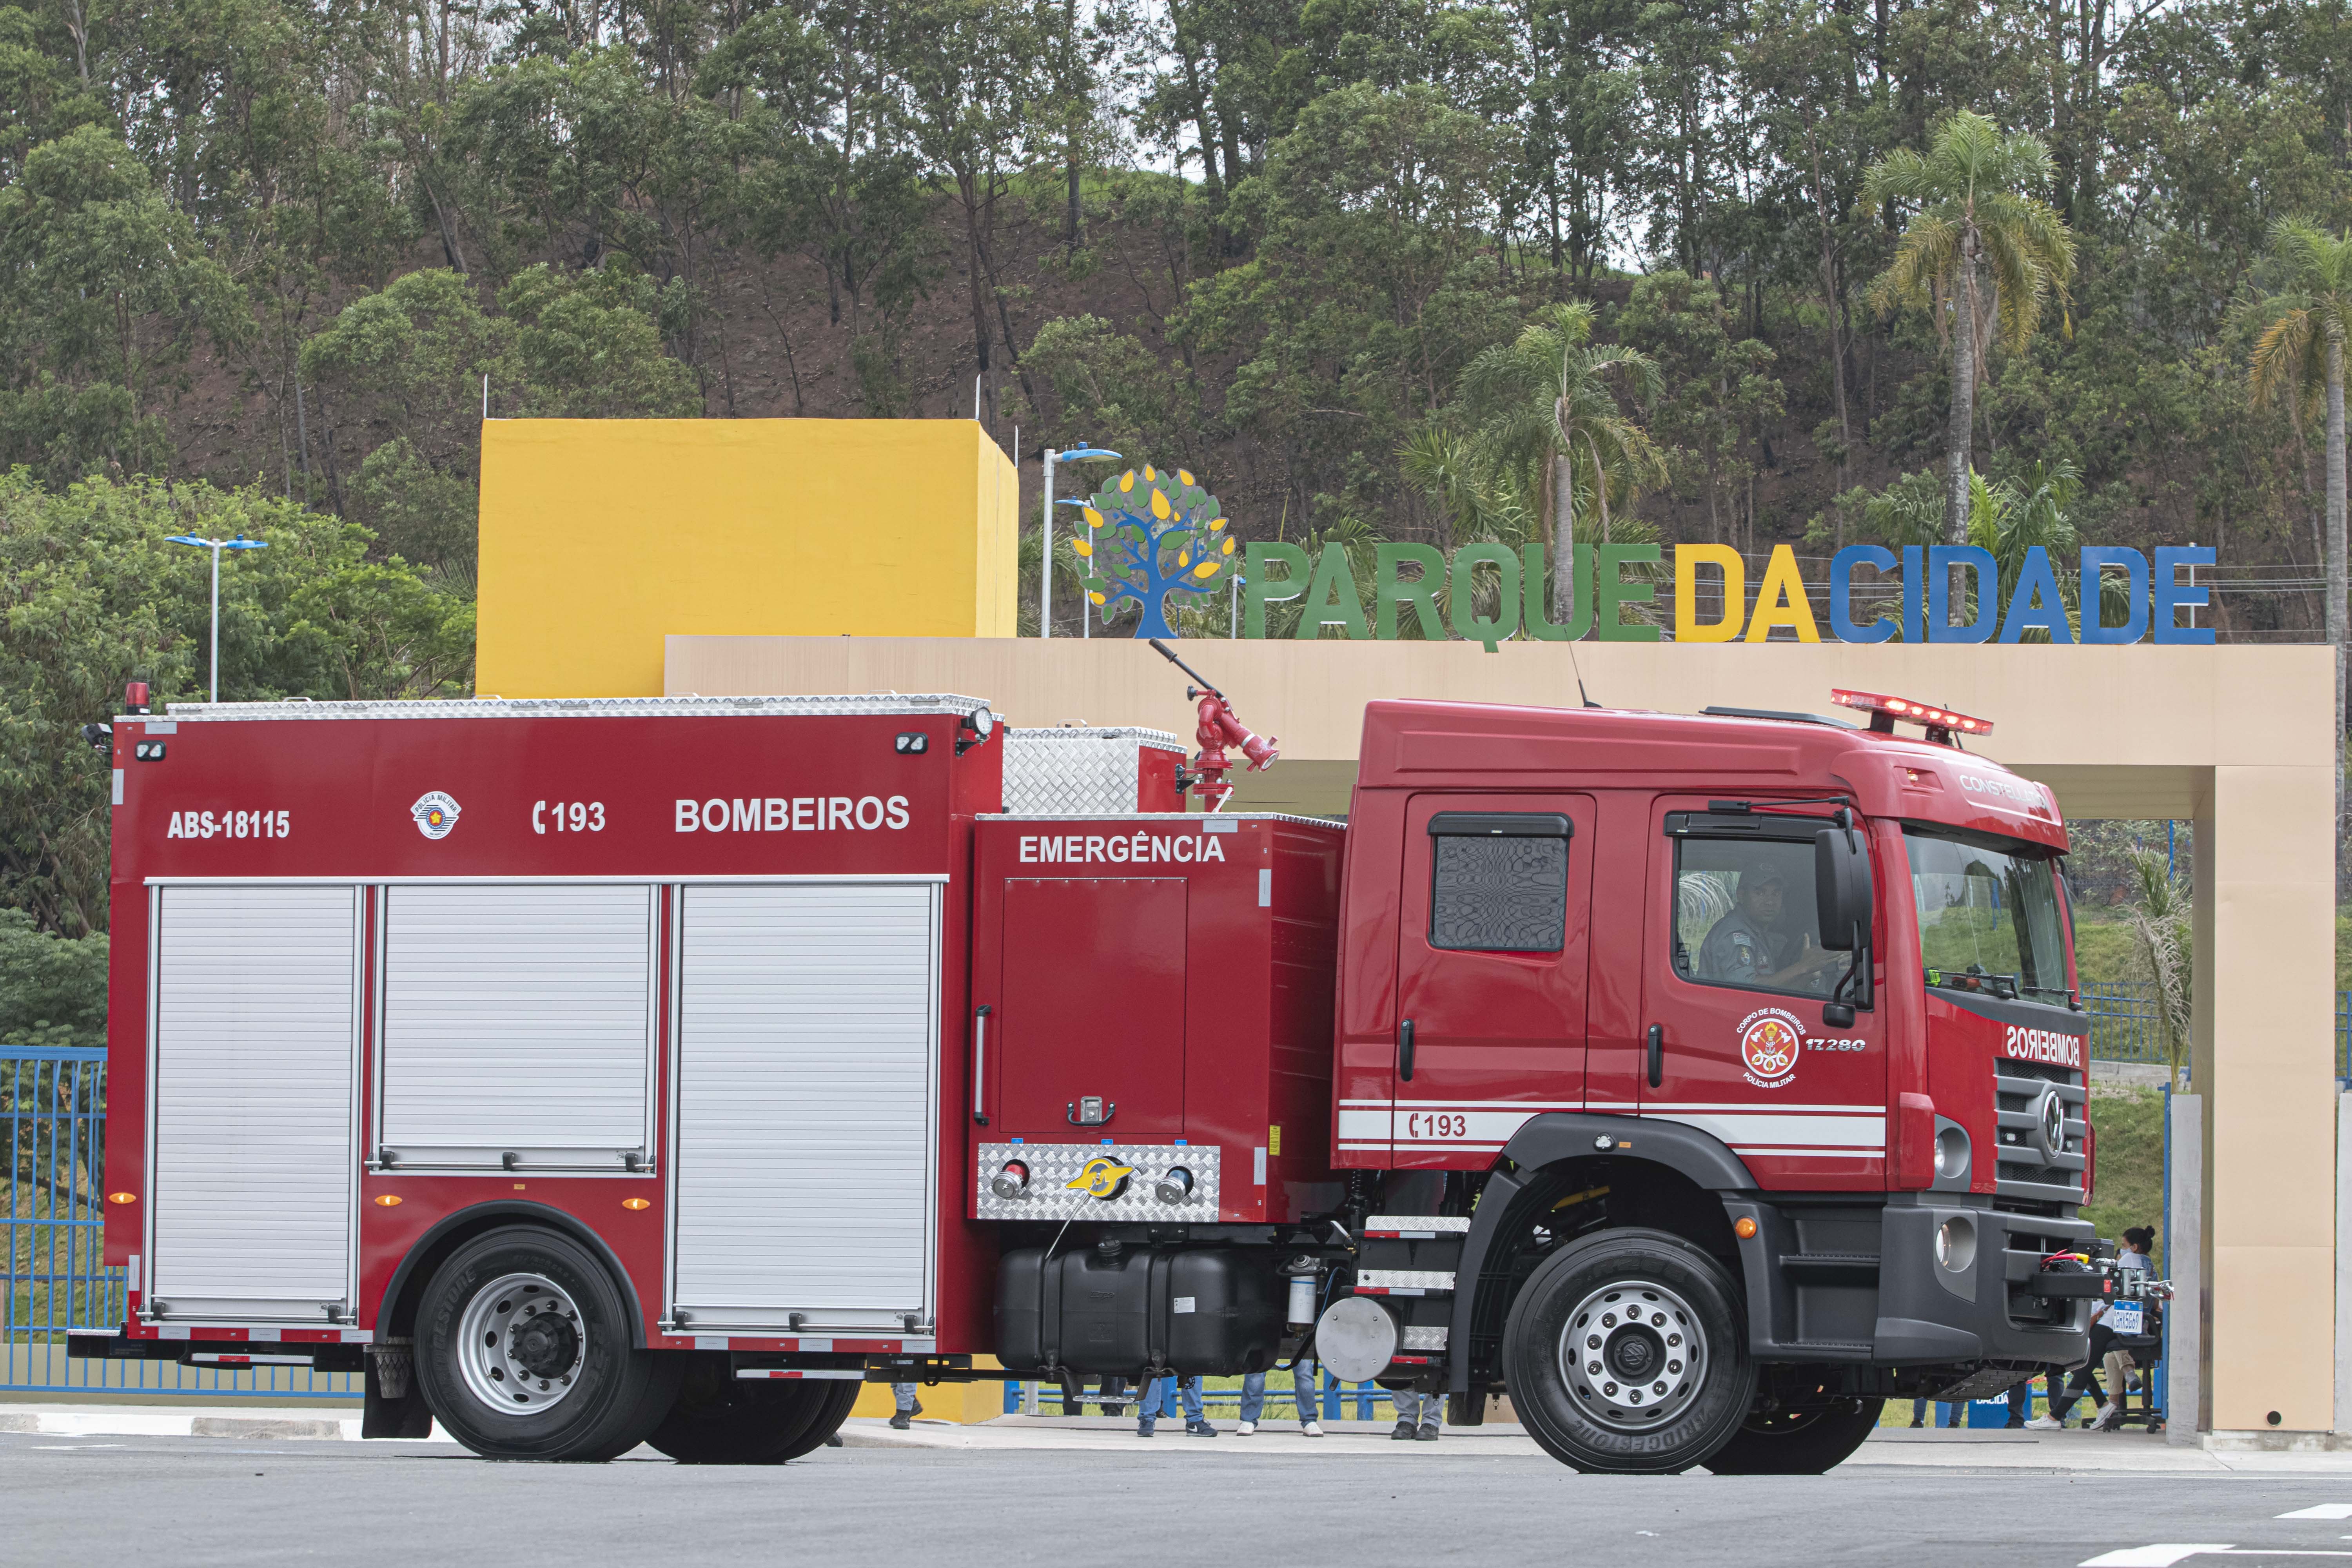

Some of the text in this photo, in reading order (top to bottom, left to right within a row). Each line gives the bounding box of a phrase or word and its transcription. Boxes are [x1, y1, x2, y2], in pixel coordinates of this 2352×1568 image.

[1245, 541, 1661, 653] PARQUE
[1830, 545, 2216, 644] CIDADE
[437, 794, 457, 812] MILITAR
[552, 802, 606, 832] 193
[675, 796, 910, 833] BOMBEIROS
[167, 811, 290, 839] ABS-18115
[1020, 830, 1225, 863] EMERGÊNCIA
[1736, 1007, 1806, 1036] CORPO DE BOMBEIROS
[1742, 1072, 1797, 1089] POLÍCIA MILITAR
[1424, 1114, 1466, 1137] 193
[1567, 1406, 1713, 1452] BRIDGESTONE
